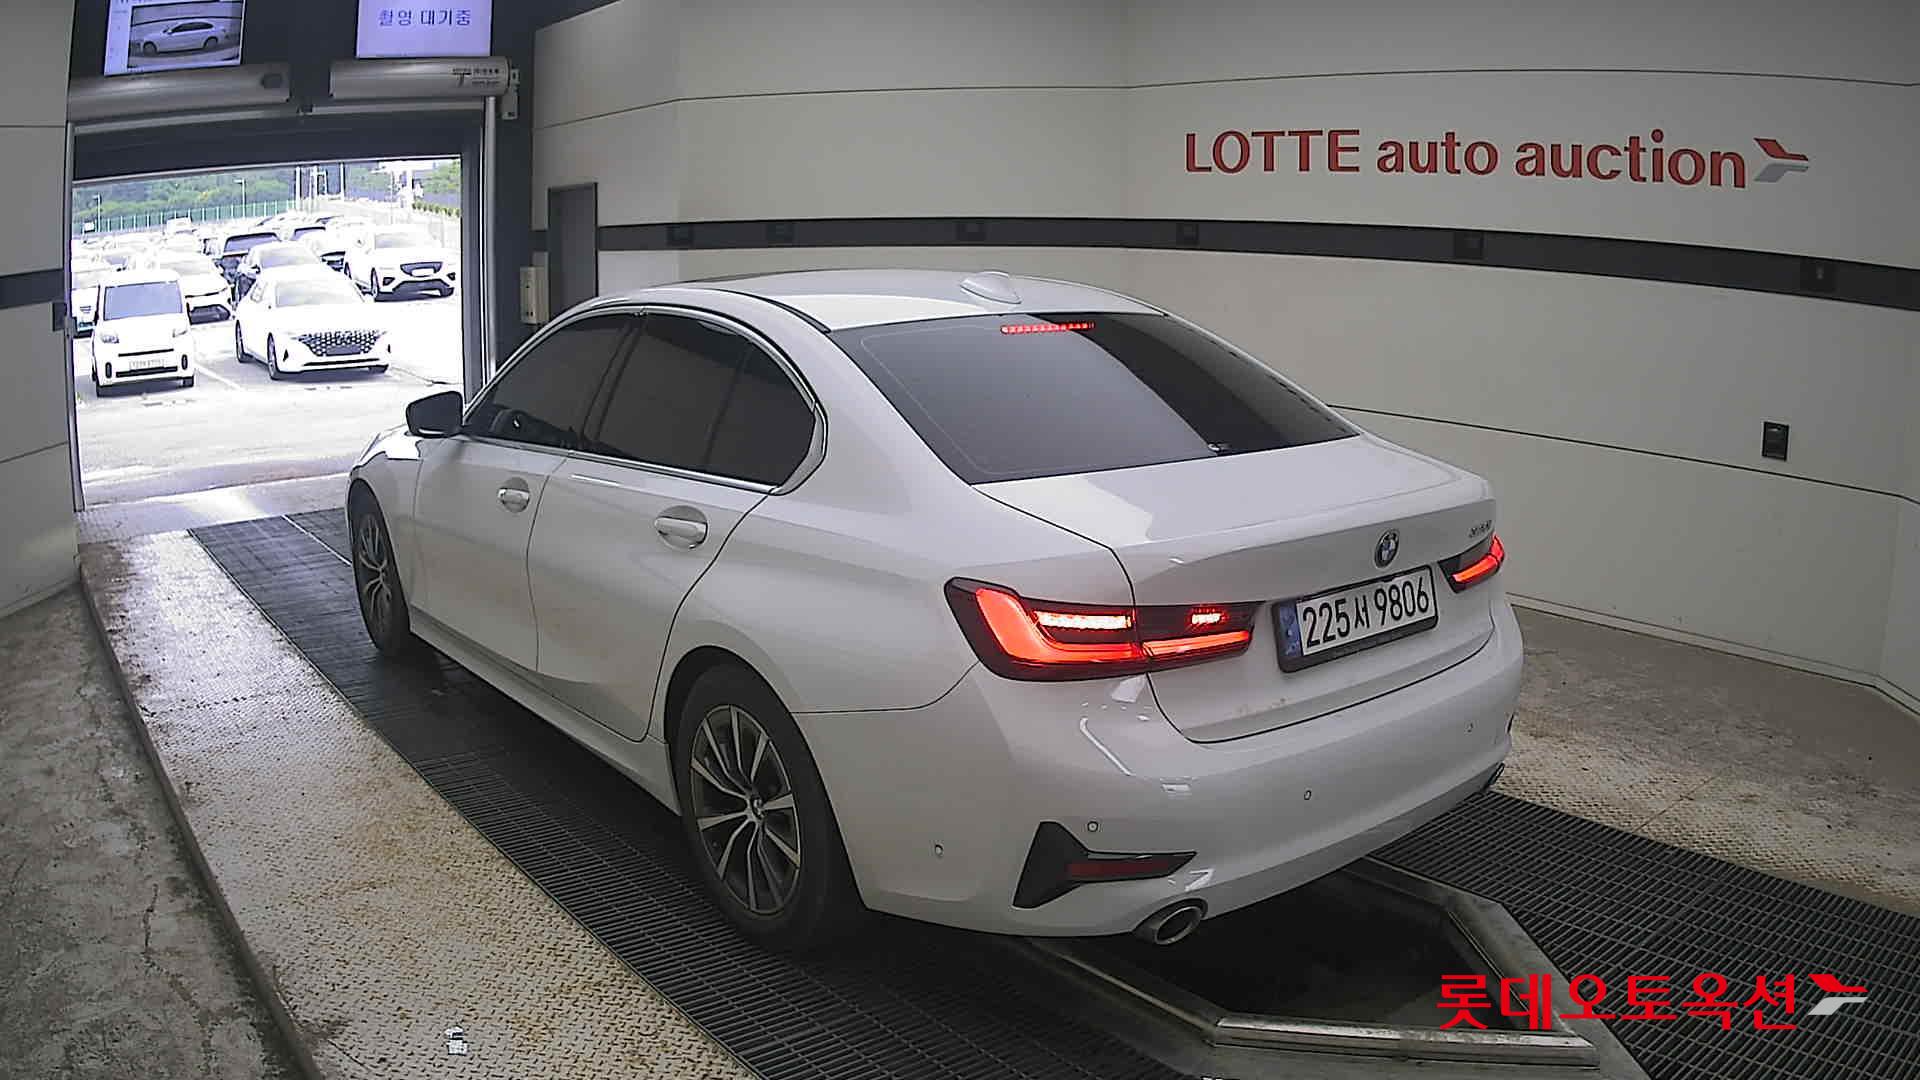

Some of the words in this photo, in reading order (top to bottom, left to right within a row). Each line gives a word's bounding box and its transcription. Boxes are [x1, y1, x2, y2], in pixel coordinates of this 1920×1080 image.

[420, 9, 471, 26] 대기중
[1185, 129, 1360, 173] LOTTE
[1376, 131, 1499, 175] auto
[1515, 129, 1746, 188] auction
[1303, 596, 1371, 648] 225서
[1374, 576, 1429, 626] 9806
